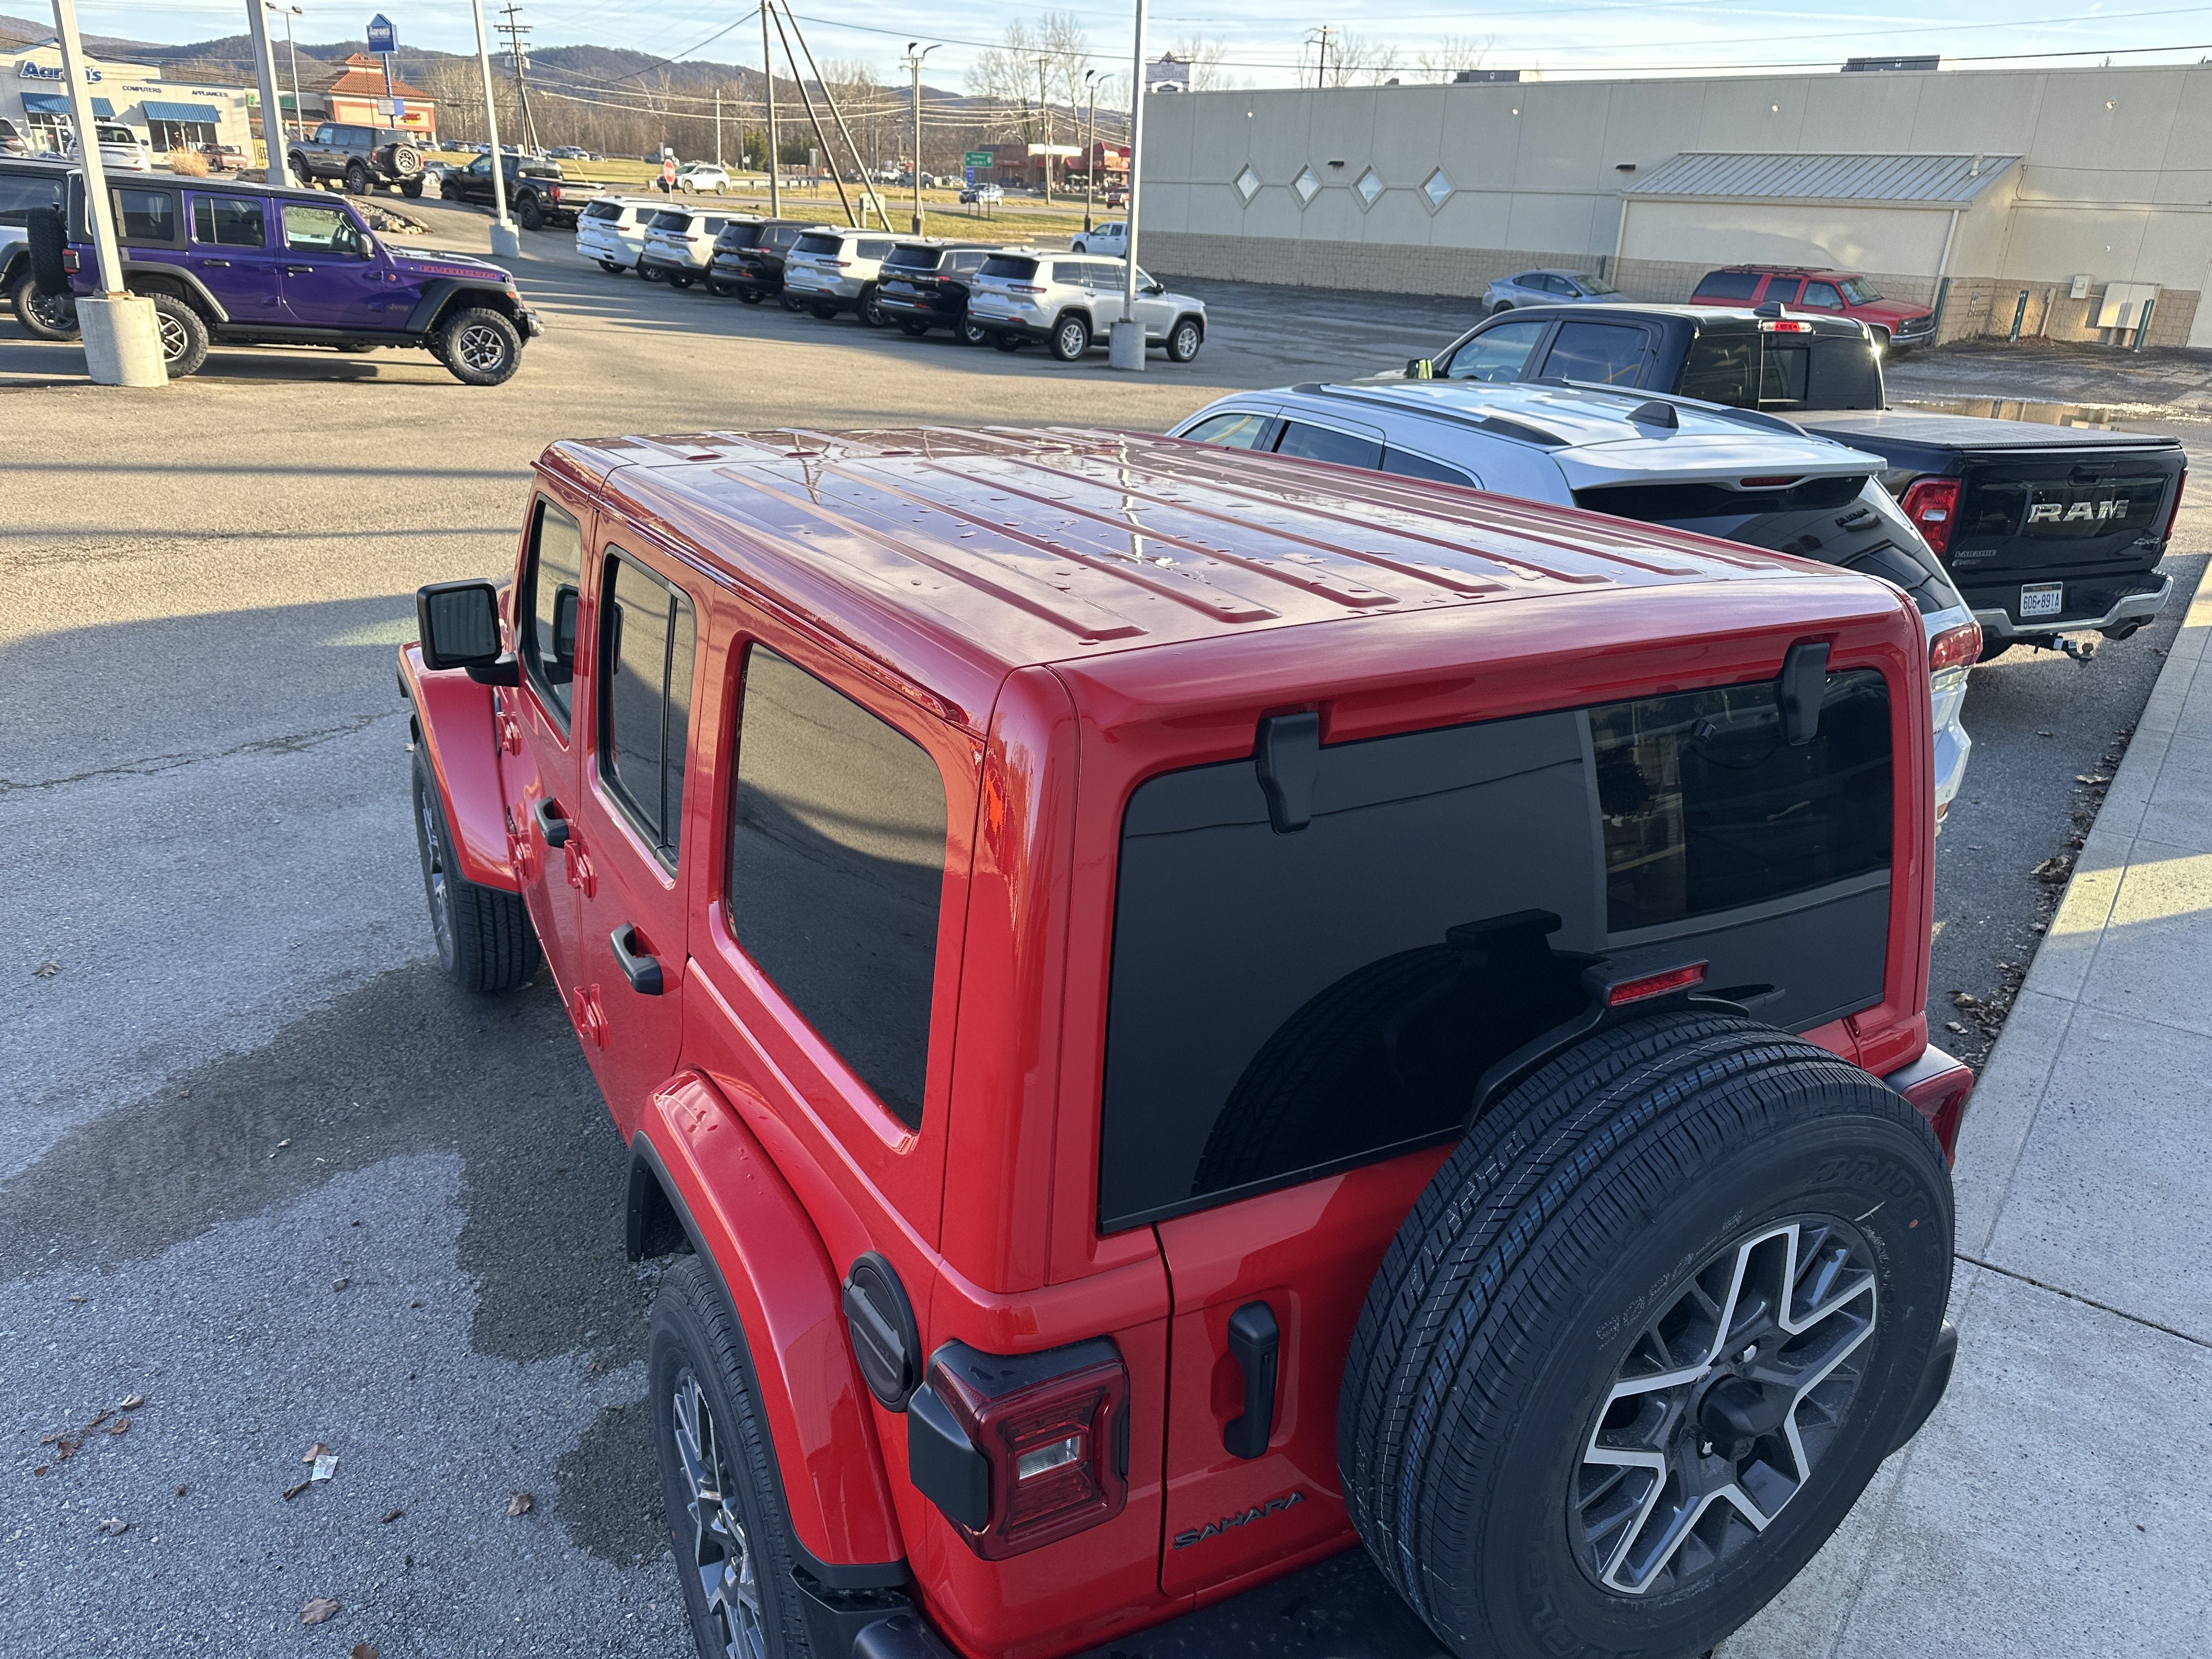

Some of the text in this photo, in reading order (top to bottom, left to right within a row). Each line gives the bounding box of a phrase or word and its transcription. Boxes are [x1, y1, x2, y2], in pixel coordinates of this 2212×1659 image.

[122, 85, 162, 93] COMPUTERS
[192, 89, 228, 98] APPLIANCES
[420, 264, 496, 280] RUBICON
[2027, 499, 2130, 523] RAM
[1172, 1491, 1307, 1550] SAHARA
